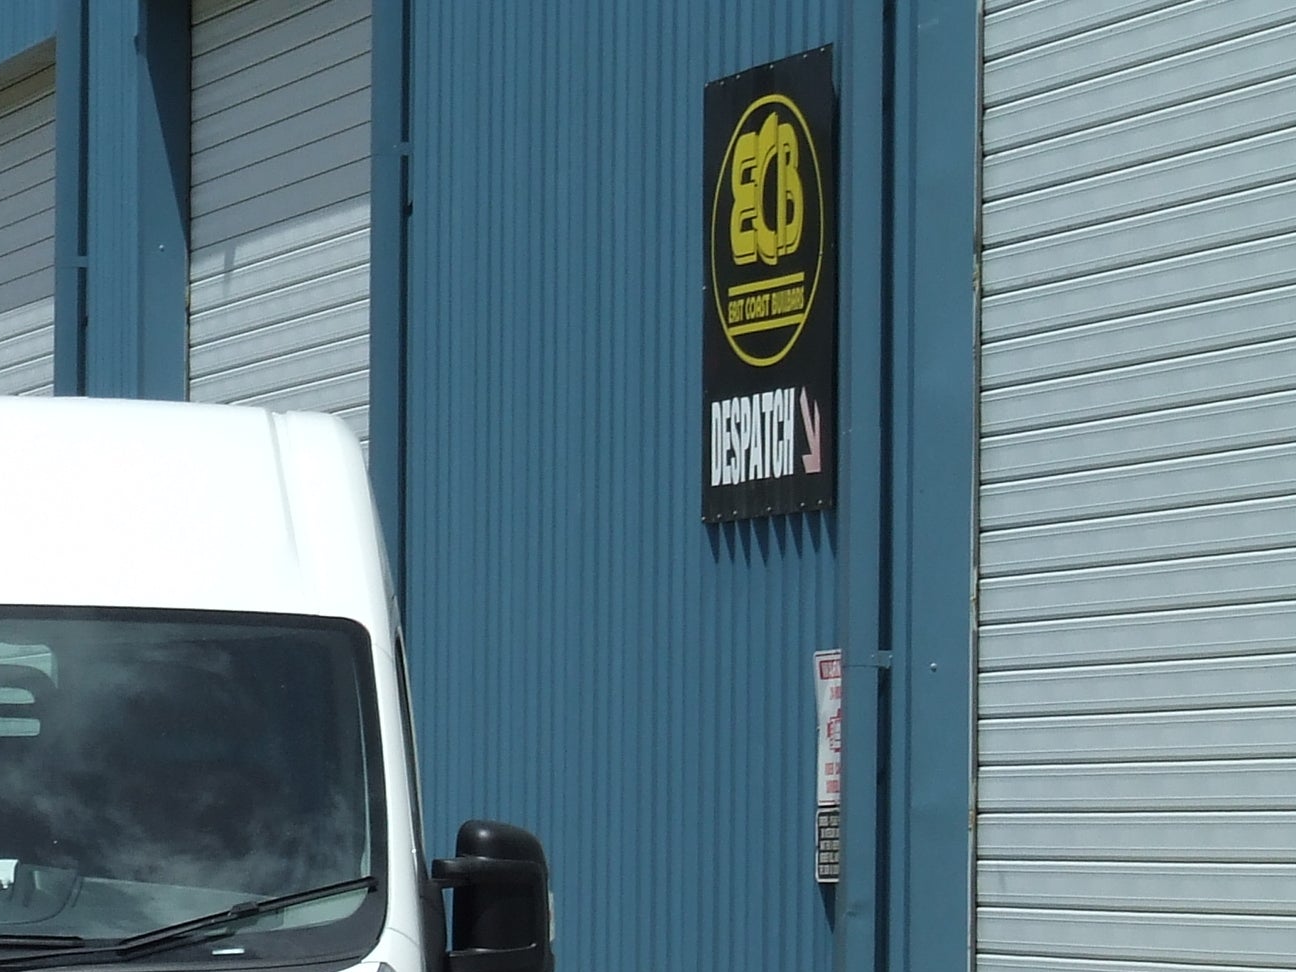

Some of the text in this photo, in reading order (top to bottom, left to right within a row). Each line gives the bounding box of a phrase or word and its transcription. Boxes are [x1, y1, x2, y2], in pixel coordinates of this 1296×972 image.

[730, 111, 803, 265] ECB
[728, 299, 744, 324] EAST
[745, 293, 771, 320] COAST
[711, 387, 795, 486] DESPATCH
